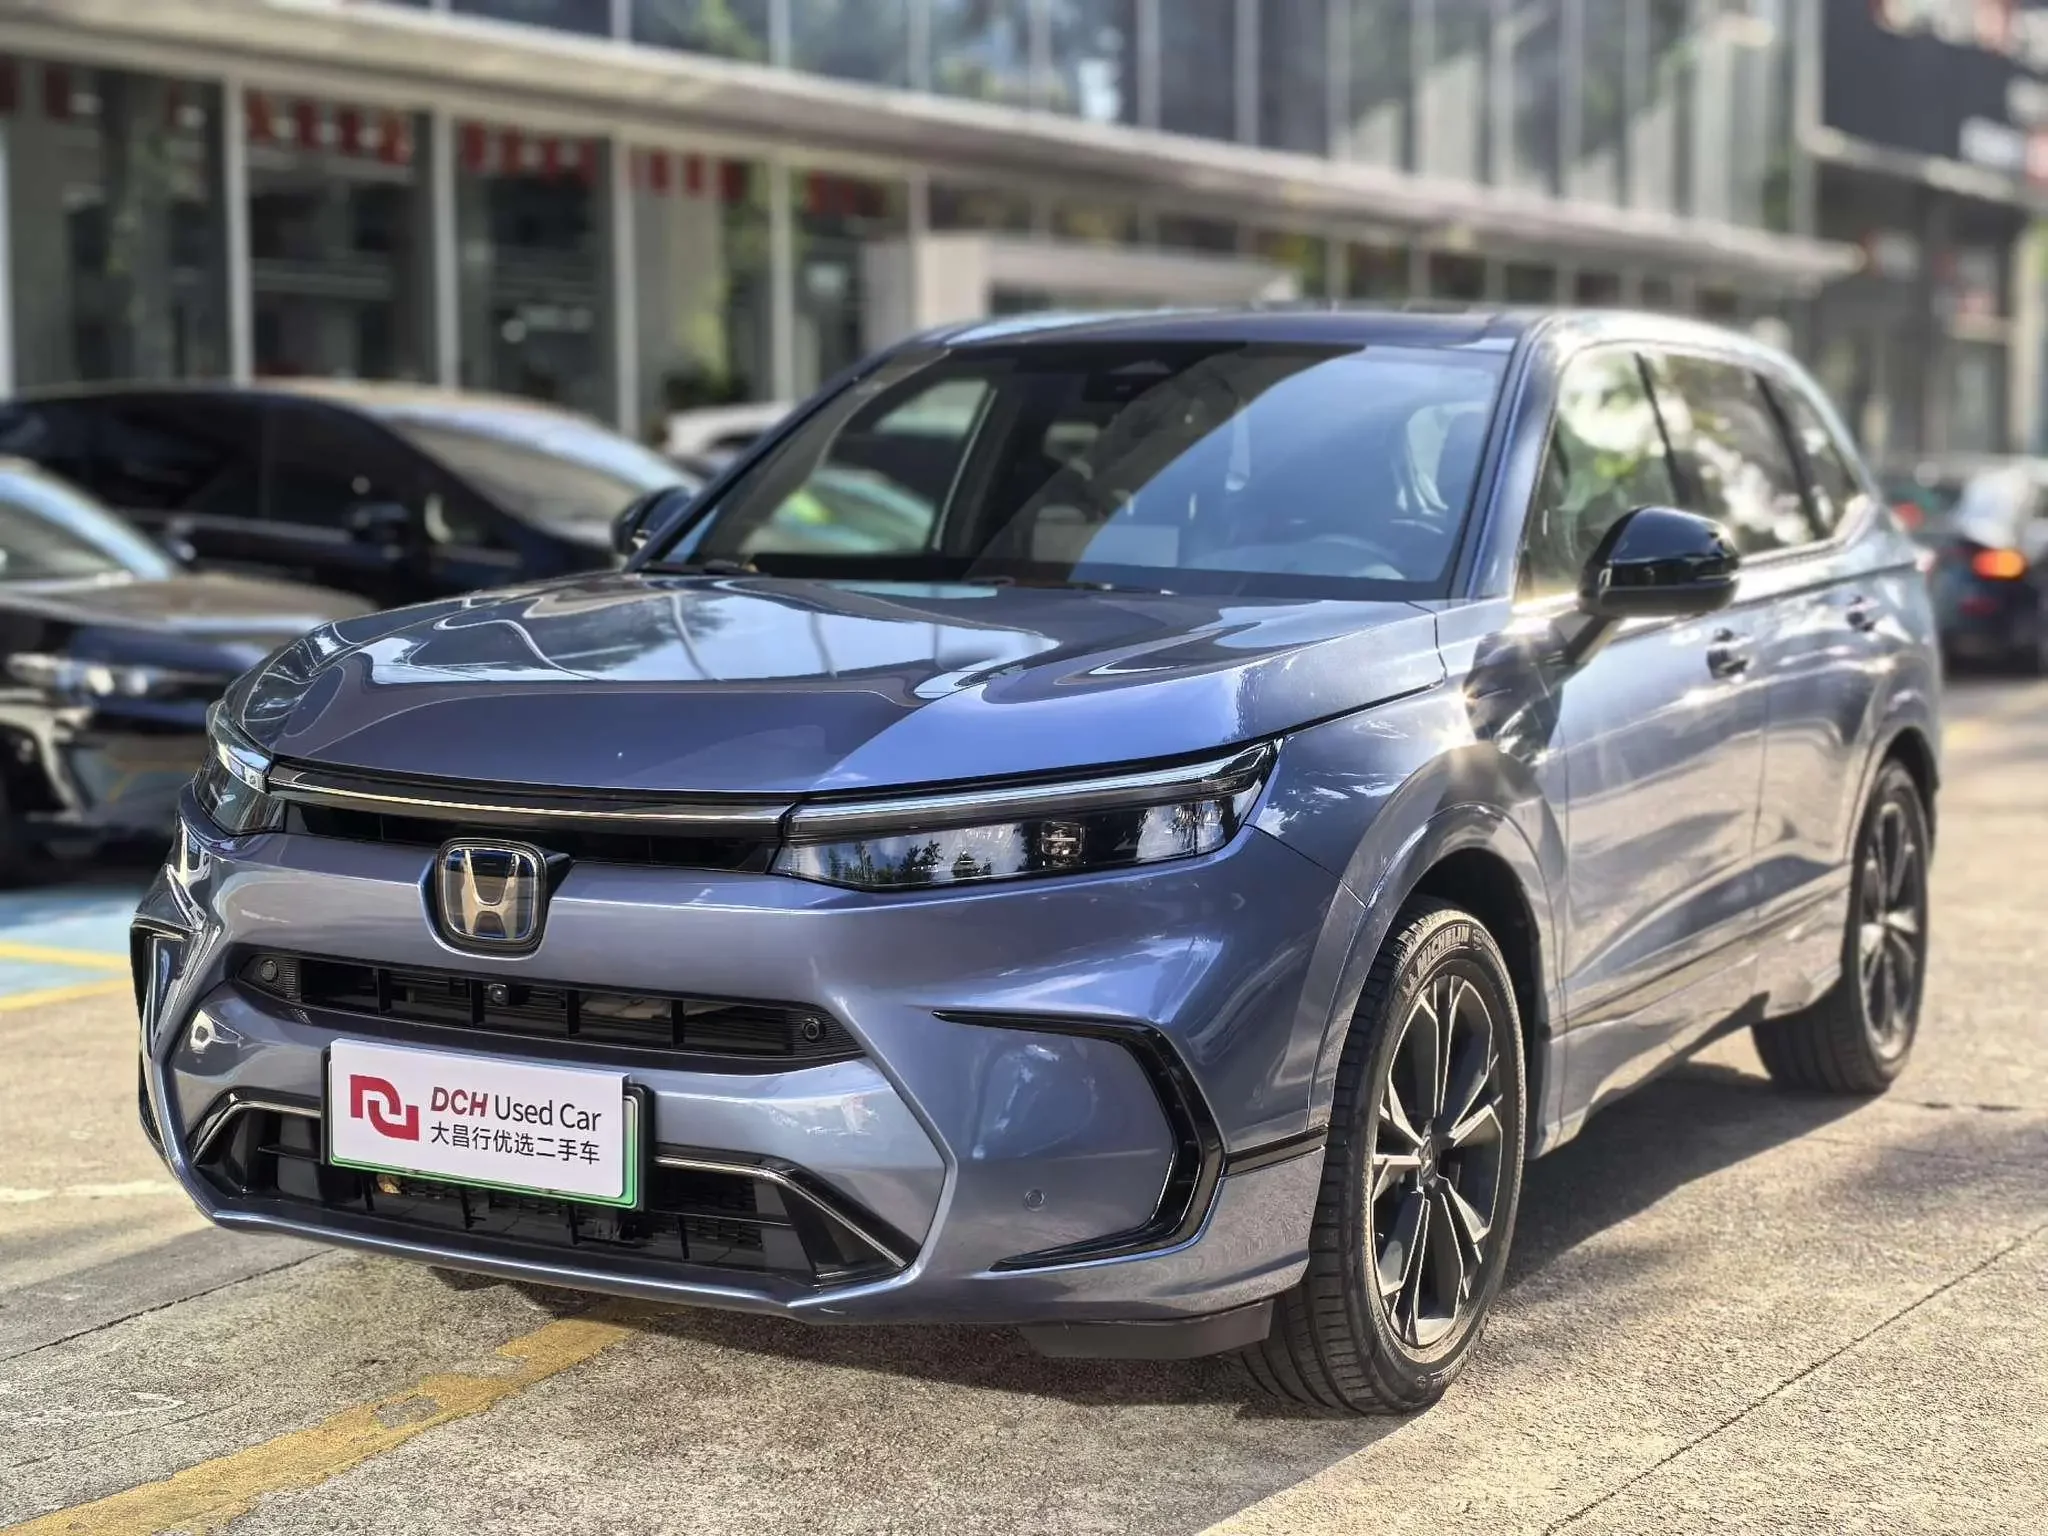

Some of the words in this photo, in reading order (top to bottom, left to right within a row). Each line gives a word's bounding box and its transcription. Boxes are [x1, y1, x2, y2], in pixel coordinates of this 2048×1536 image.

[430, 1086, 489, 1118] DCH
[494, 1095, 554, 1127] Used
[559, 1102, 602, 1132] Car
[430, 1121, 601, 1165] 大昌行优选二手车
